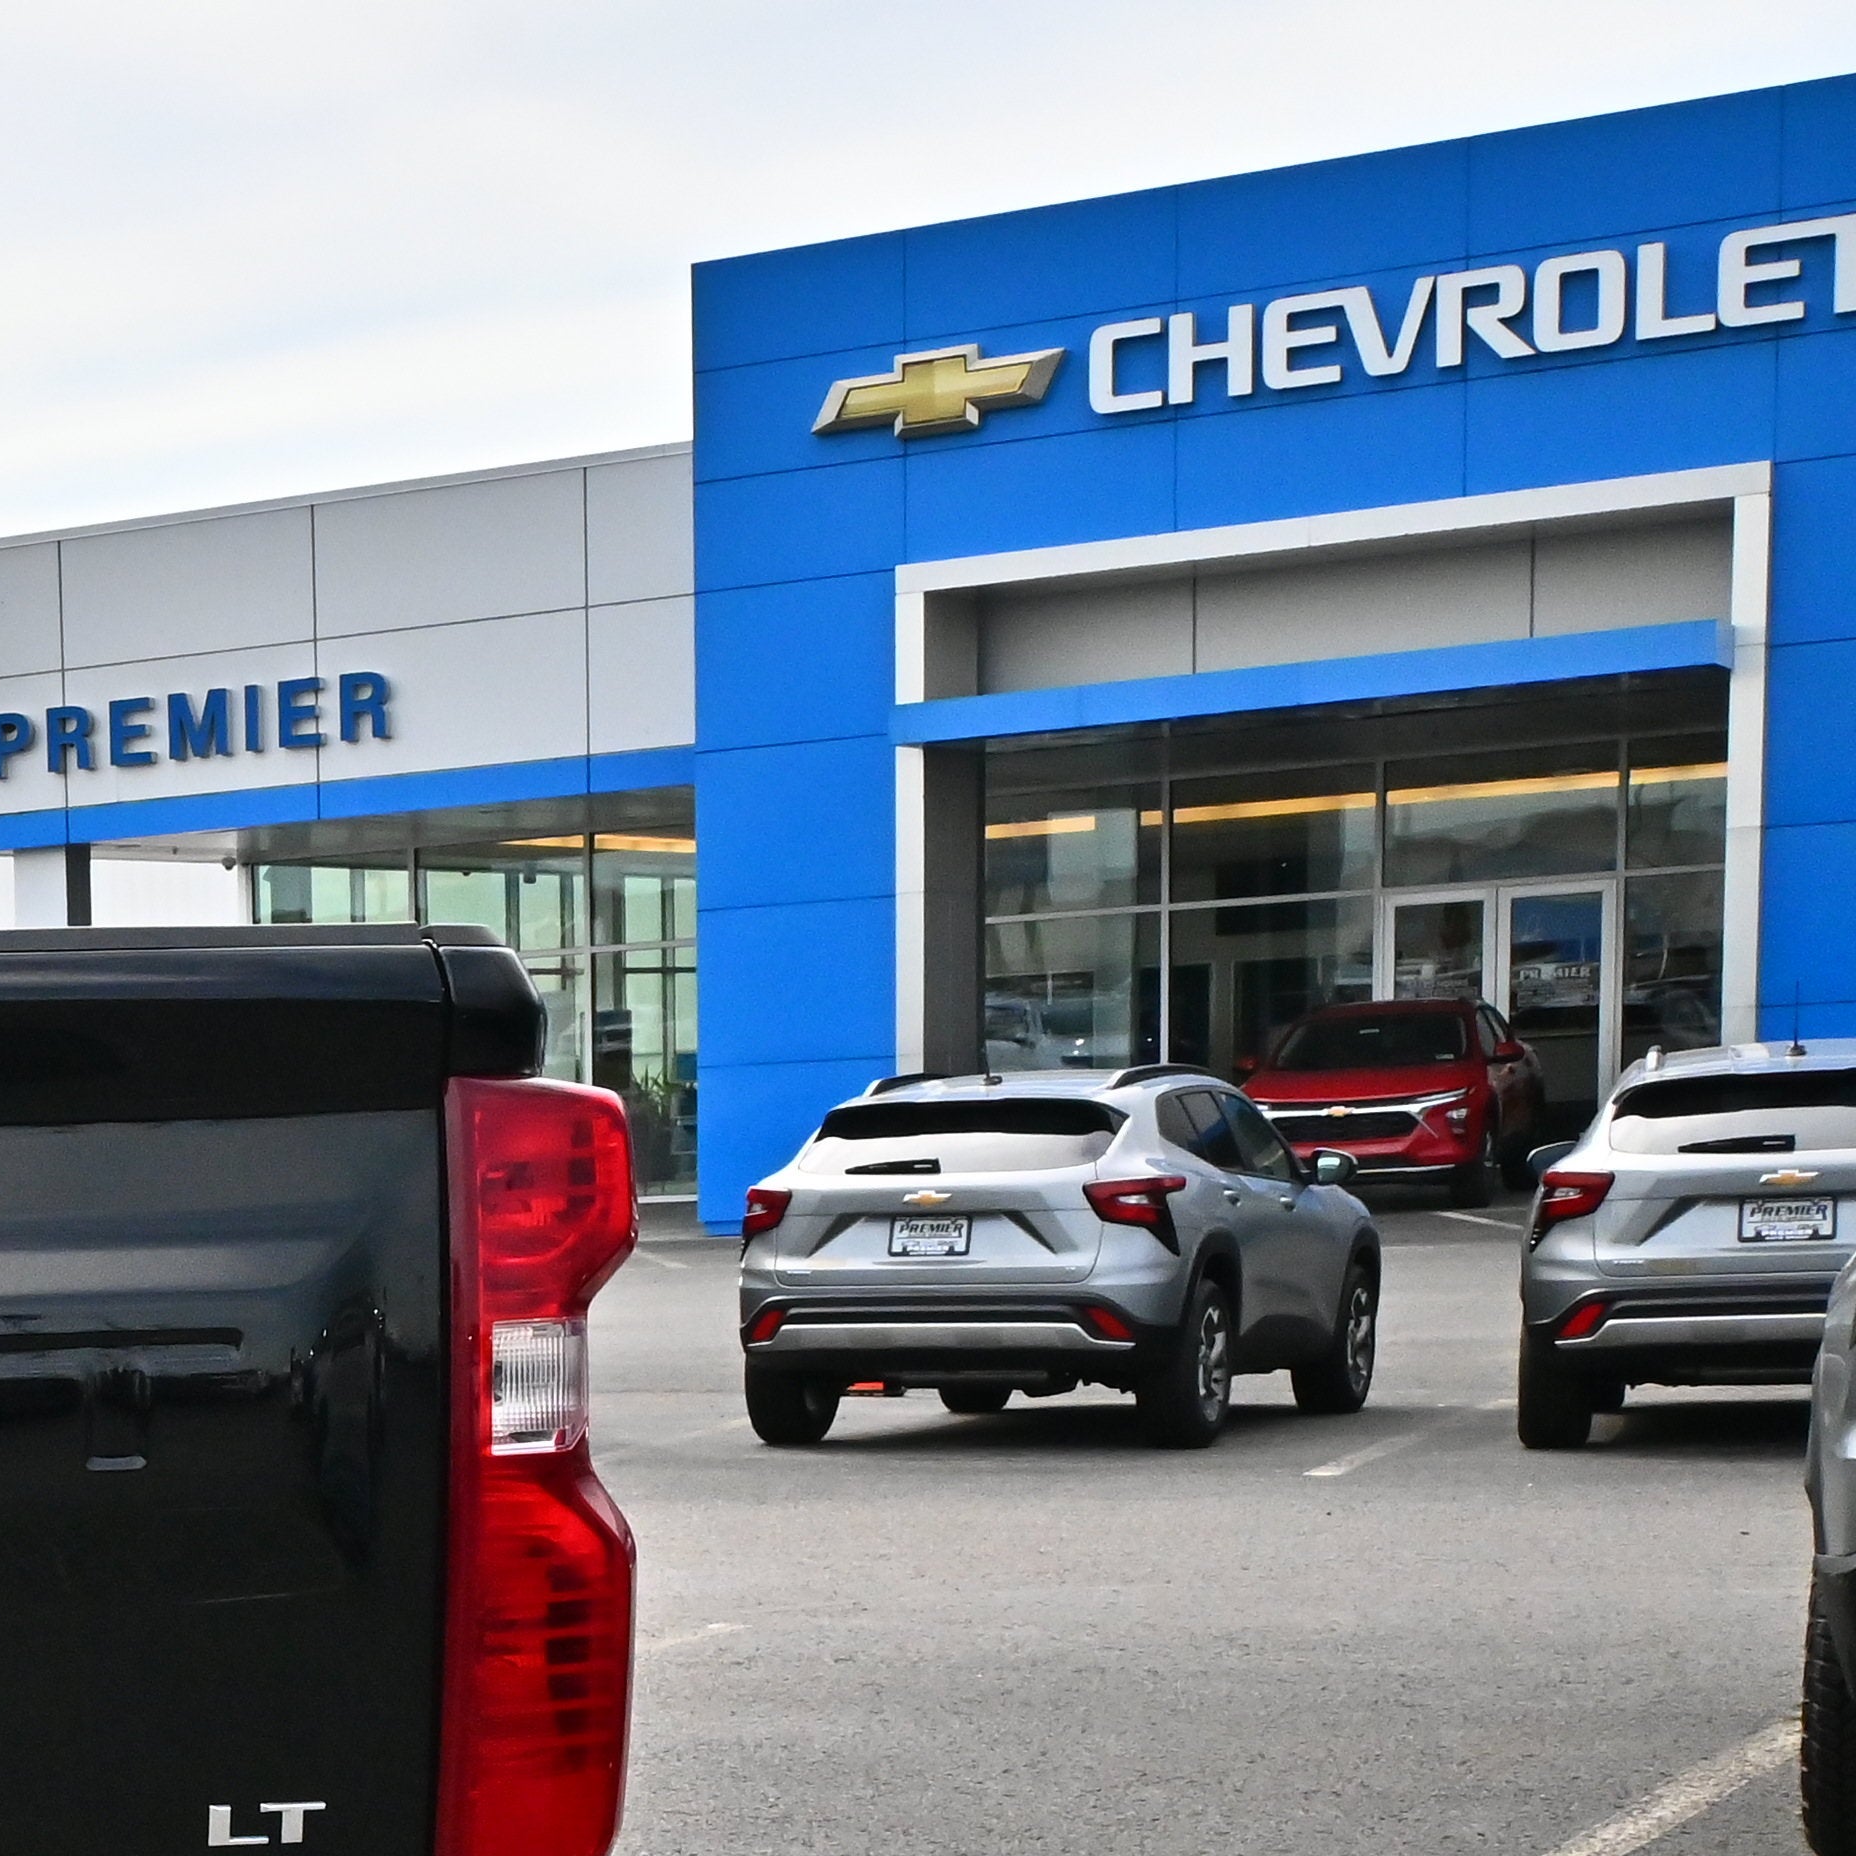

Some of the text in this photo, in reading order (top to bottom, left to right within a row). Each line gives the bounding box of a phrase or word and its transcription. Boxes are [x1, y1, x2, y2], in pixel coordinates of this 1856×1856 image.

[1087, 211, 1856, 415] CHEVROLET
[1750, 1205, 1828, 1220] PREMIER
[899, 1223, 964, 1237] PREMIER
[208, 1801, 327, 1847] LT
